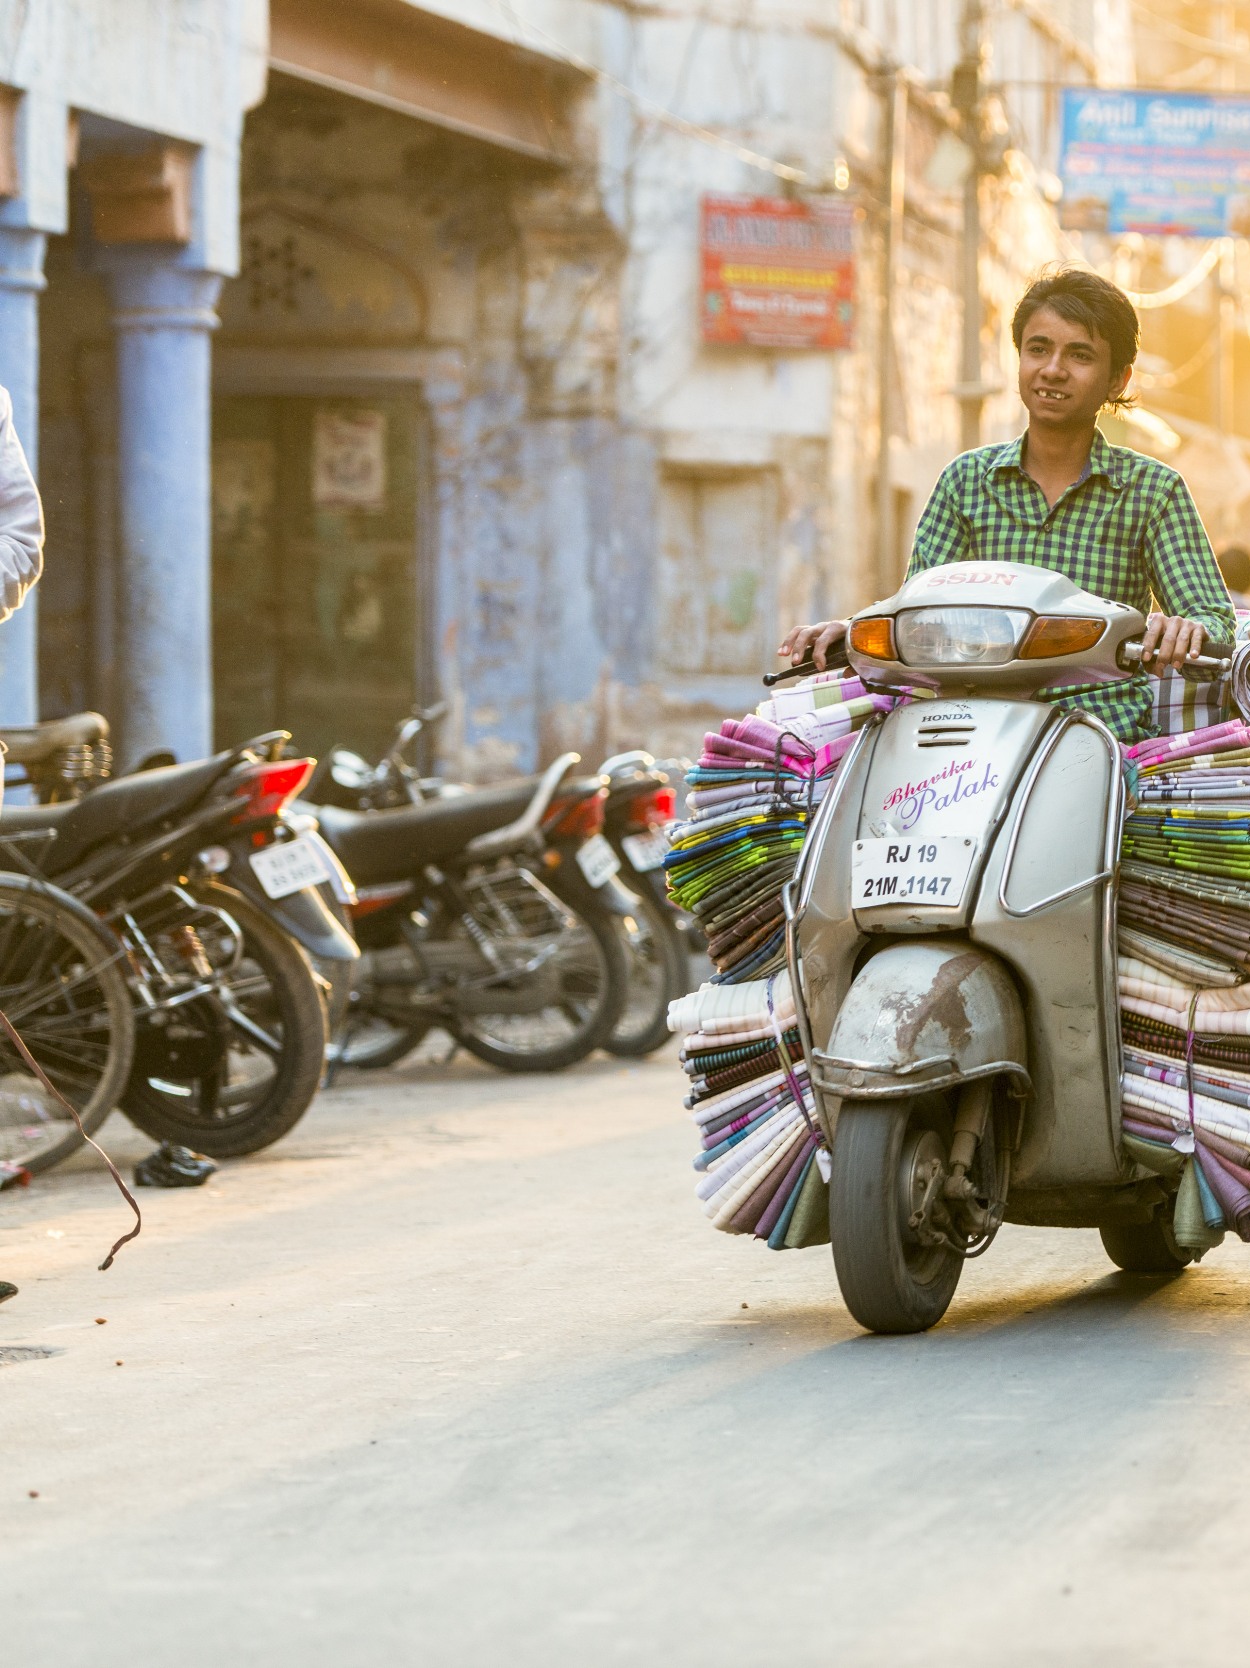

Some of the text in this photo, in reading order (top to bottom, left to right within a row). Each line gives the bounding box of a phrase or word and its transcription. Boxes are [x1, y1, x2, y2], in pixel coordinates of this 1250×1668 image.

[927, 571, 1018, 588] SSDN
[921, 713, 974, 723] HONDA
[883, 758, 978, 811] Bhavika
[895, 762, 1000, 830] Palak
[886, 844, 938, 864] RJ 19
[863, 875, 952, 898] 21M 1147
